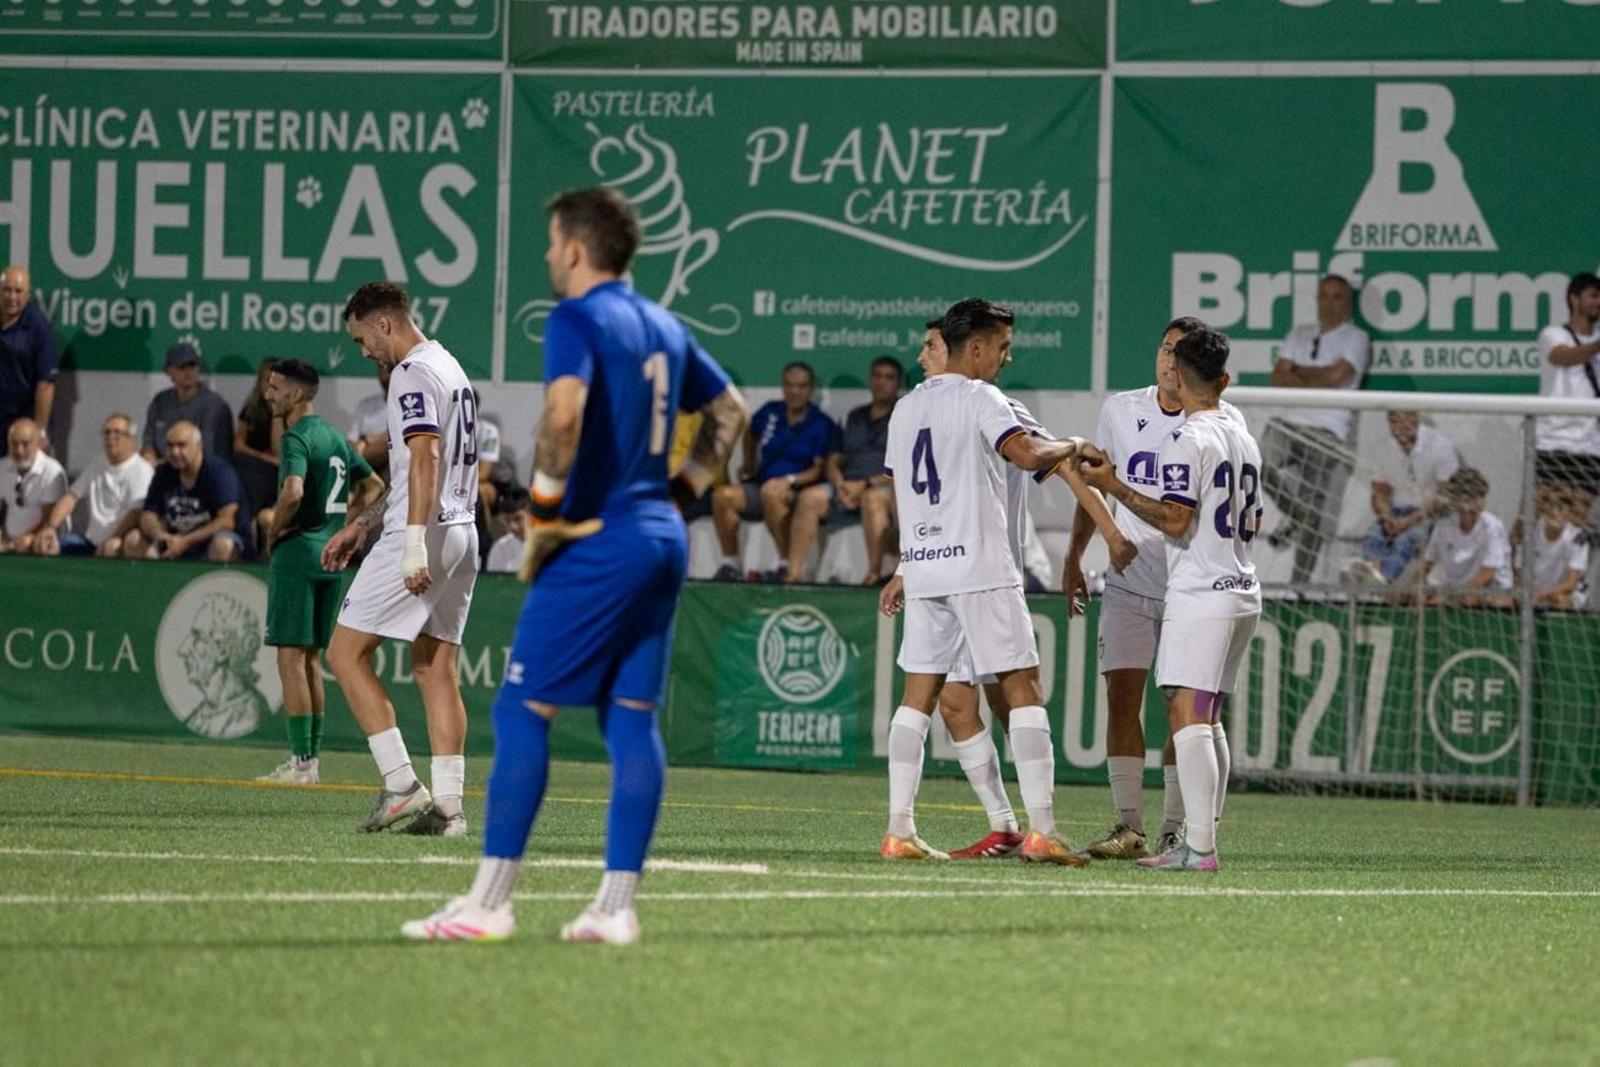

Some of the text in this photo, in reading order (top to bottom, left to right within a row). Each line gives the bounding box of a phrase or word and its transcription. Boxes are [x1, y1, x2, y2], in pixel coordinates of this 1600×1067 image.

[549, 6, 1057, 39] TIRADORES PARA MOBILIARIO
[736, 41, 862, 62] MADE IN SPAIN
[552, 88, 715, 118] PASTELERÍA
[179, 108, 460, 153] VETERINARIA
[746, 122, 1008, 187] PLANET
[844, 181, 1073, 230] CAFETERÍA
[1350, 223, 1482, 247] BRIFORMA
[35, 287, 157, 337] Virgen
[169, 291, 229, 330] del
[1400, 347, 1413, 368] &
[1423, 346, 1541, 369] BRICOLAG
[452, 387, 478, 467] 19
[643, 352, 670, 455] 1
[325, 456, 350, 514] 2
[911, 427, 942, 505] 4
[757, 710, 842, 745] TERCERA
